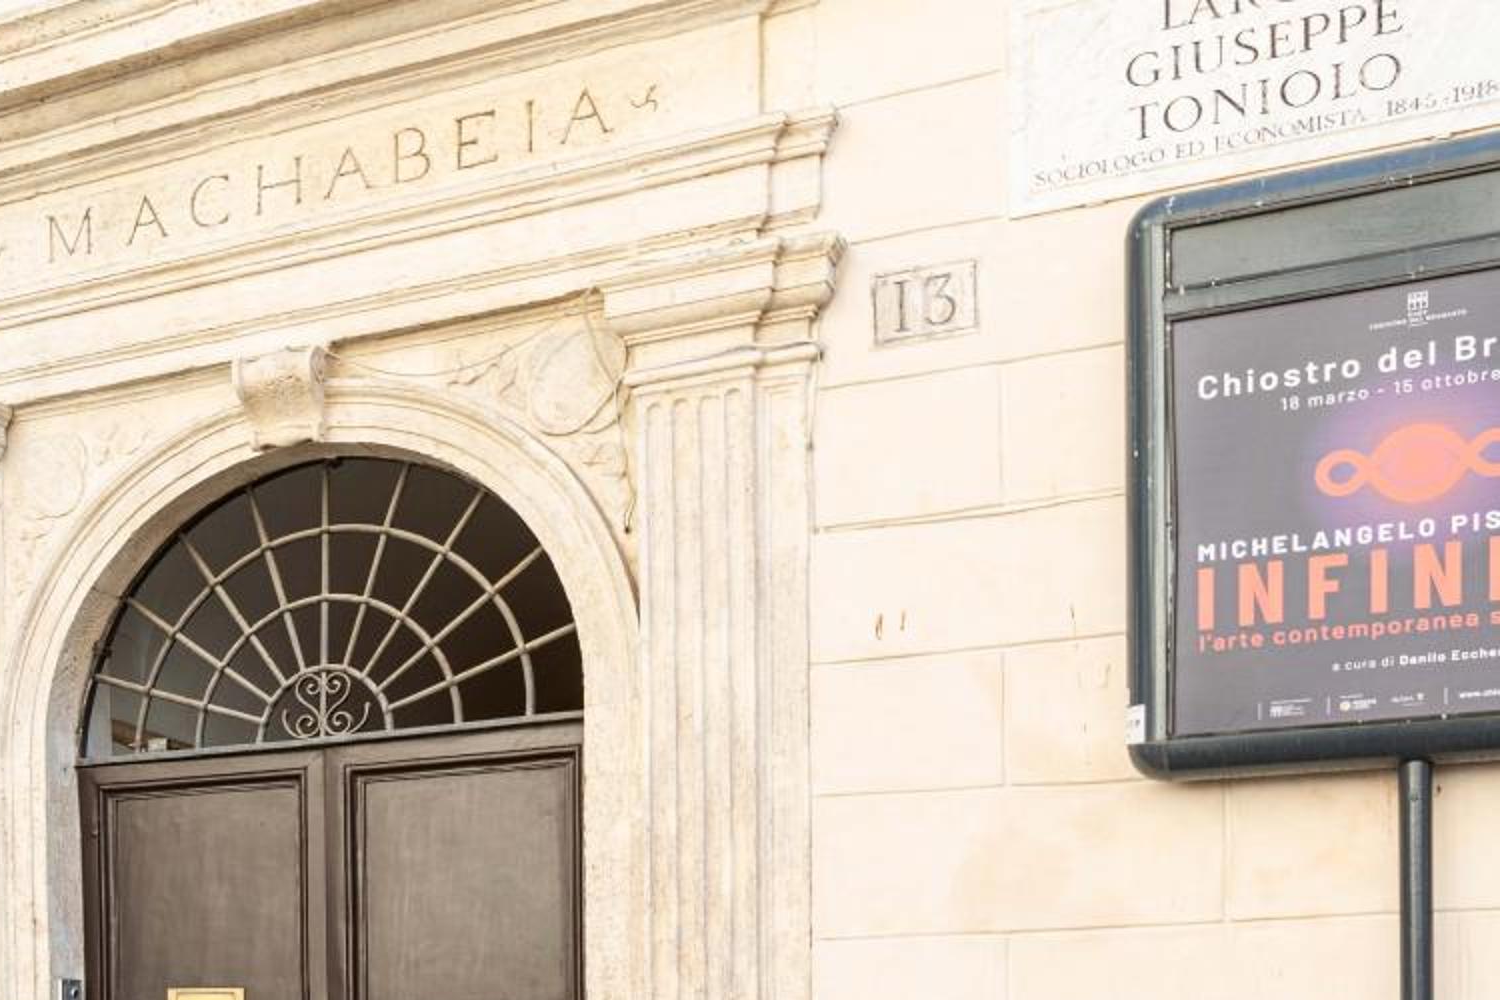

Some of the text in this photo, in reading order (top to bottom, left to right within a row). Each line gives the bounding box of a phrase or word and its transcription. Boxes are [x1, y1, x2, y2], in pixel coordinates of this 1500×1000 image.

[1125, 0, 1406, 88] GIUSEPPE
[1128, 53, 1403, 140] TONIOLO
[45, 87, 615, 264] MACHABEIA
[1034, 149, 1165, 187] SOCIOLOGO
[1175, 141, 1205, 159] ED
[1214, 108, 1366, 153] ECONOMISTA
[892, 271, 957, 333] 13
[1197, 334, 1498, 400] Chiostro del Br
[1281, 396, 1301, 412] 18
[1307, 387, 1370, 409] marzo
[1421, 369, 1500, 391] ottobre
[1197, 509, 1500, 562] MICHELANGELO PIS
[1198, 632, 1264, 652] l'arte
[1271, 611, 1480, 646] contemporanea
[1399, 651, 1447, 666] Danilo
[1450, 648, 1500, 661] Ecche
